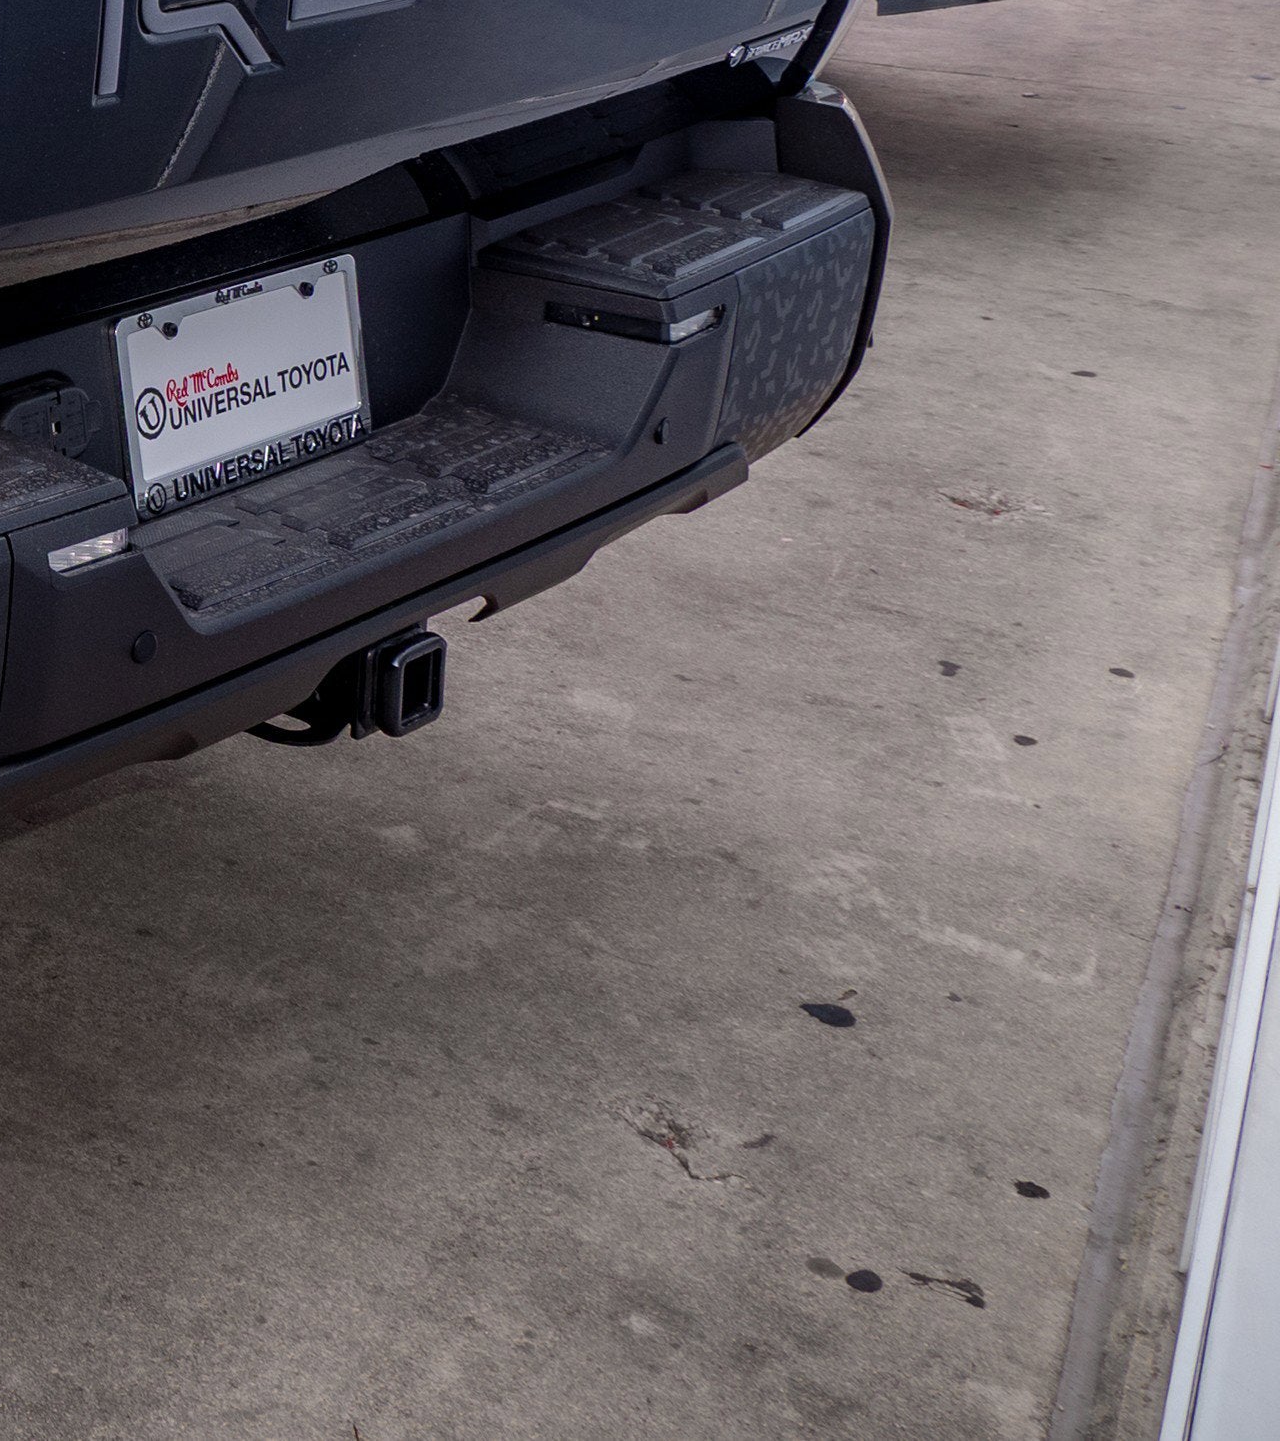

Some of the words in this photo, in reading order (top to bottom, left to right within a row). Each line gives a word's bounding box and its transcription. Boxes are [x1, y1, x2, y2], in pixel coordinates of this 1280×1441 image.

[165, 378, 190, 408] Red
[190, 363, 239, 392] McCombs
[169, 376, 276, 430] UNIVERSAL
[276, 351, 351, 393] TOYOTA
[173, 441, 290, 502] UNIVERSAL
[291, 413, 367, 460] TOYOTA
